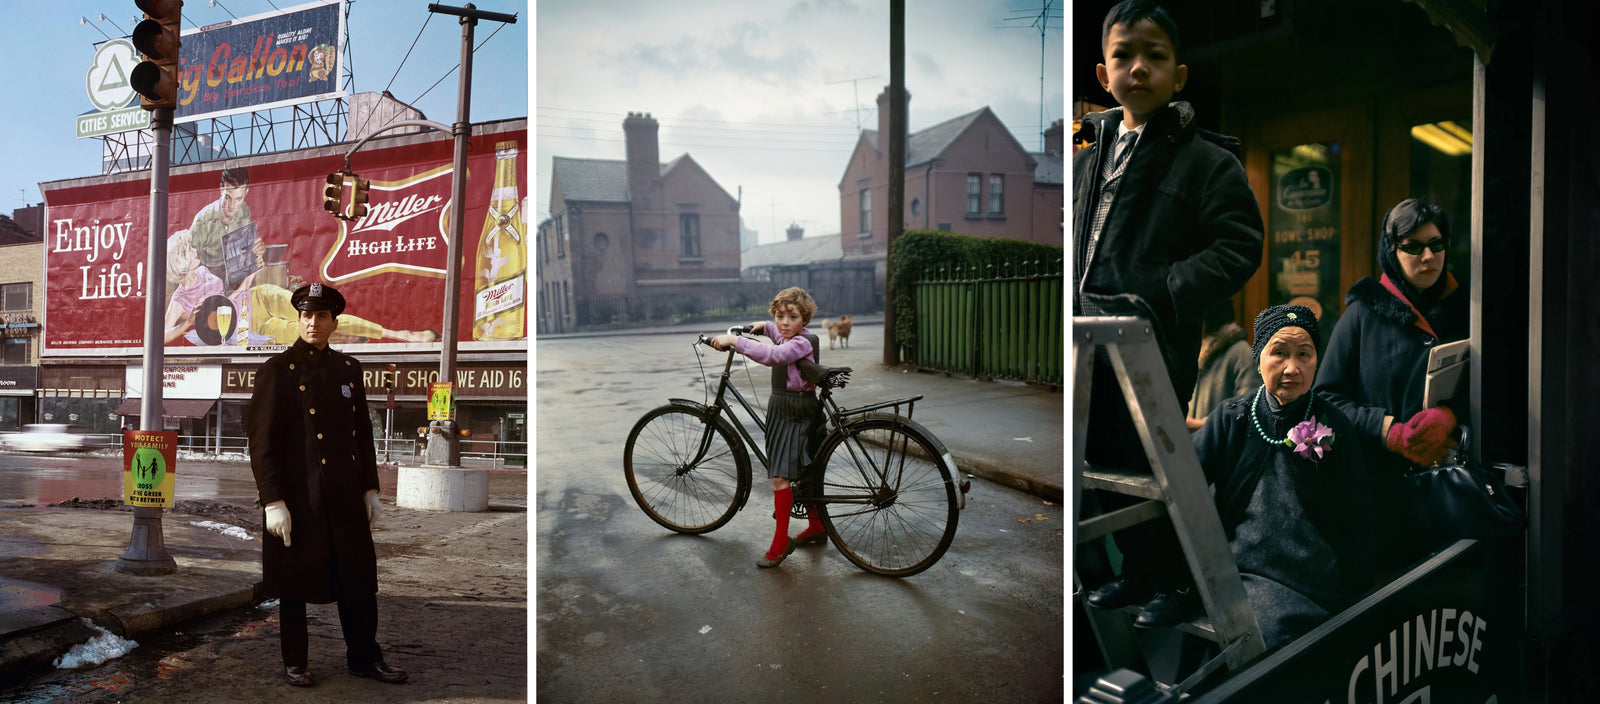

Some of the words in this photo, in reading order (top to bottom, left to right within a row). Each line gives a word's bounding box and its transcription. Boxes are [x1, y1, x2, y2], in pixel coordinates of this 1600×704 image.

[178, 57, 204, 106] ig
[206, 33, 308, 87] Gallon
[202, 91, 219, 103] Big
[276, 76, 300, 89] Too!
[79, 116, 108, 133] CITIES
[110, 110, 147, 129] SERVICE
[346, 193, 443, 234] Miller
[52, 218, 133, 262] Enjoy
[347, 239, 393, 258] HIGH
[395, 235, 437, 252] LIFE
[79, 261, 144, 300] Life!
[407, 370, 440, 388] SHO
[456, 370, 476, 388] WE
[479, 370, 505, 388] AID
[508, 370, 522, 388] 16
[1348, 608, 1487, 704] CHINESE
